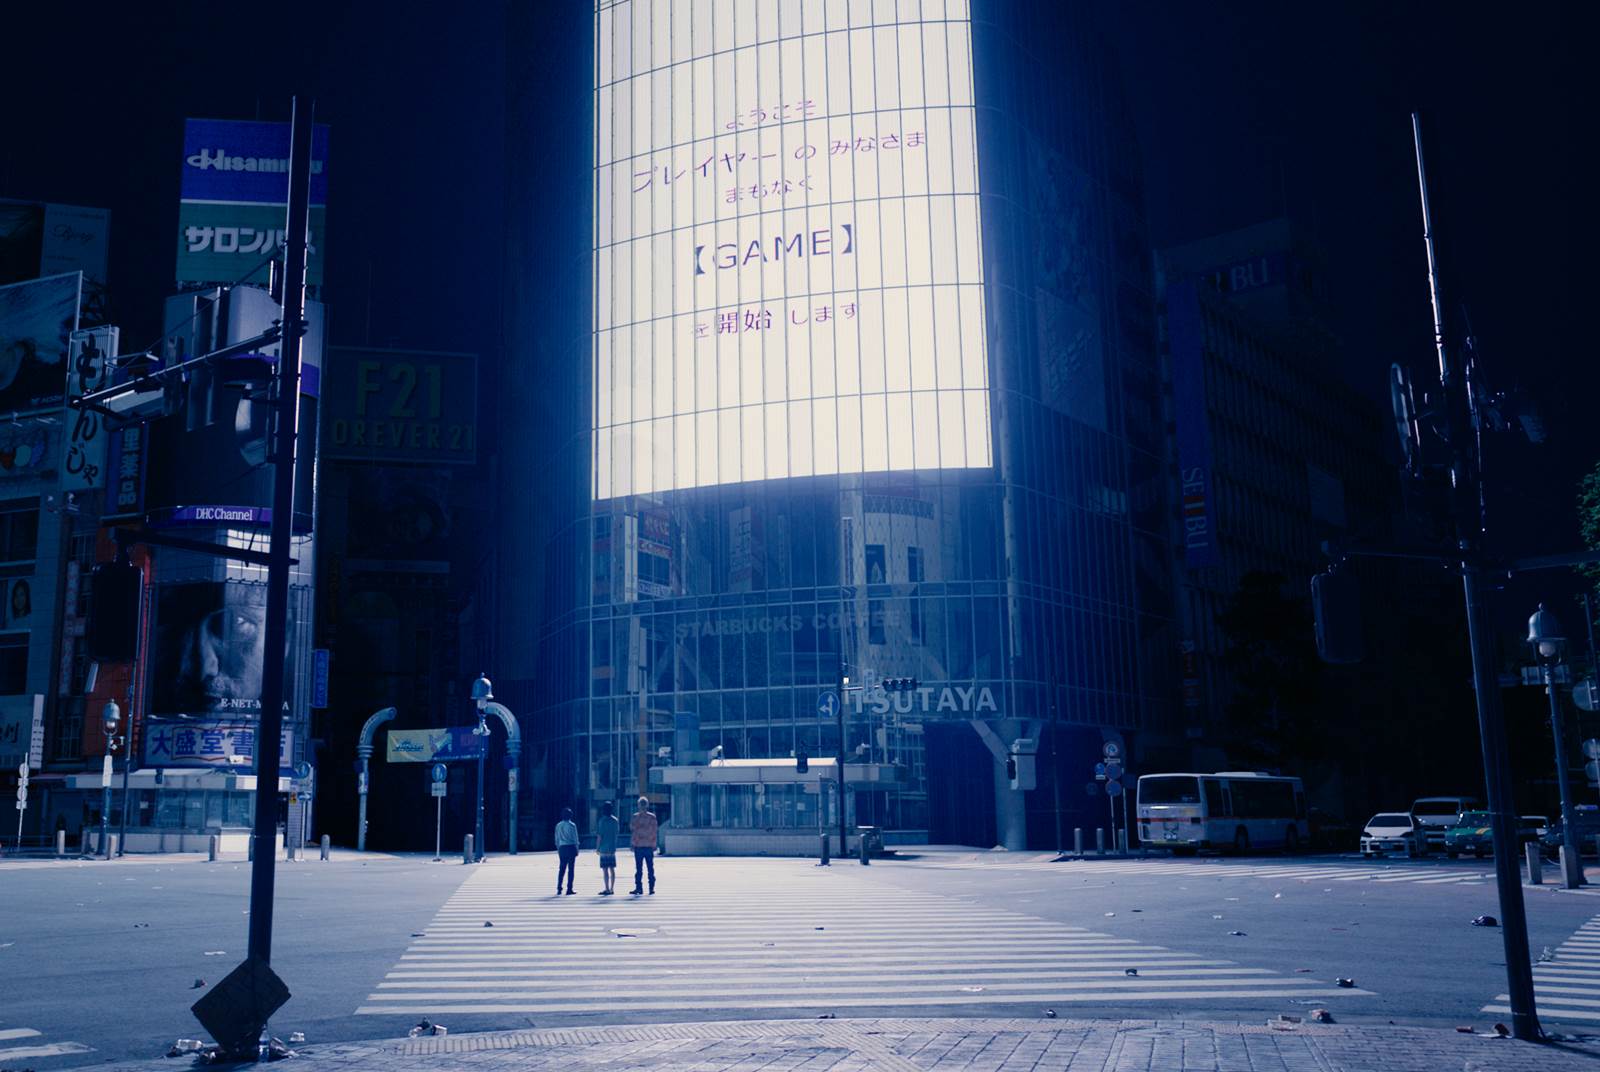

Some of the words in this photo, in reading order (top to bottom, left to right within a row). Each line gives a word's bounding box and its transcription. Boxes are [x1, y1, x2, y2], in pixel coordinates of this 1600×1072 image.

[725, 100, 816, 130] ようこそ
[725, 175, 814, 204] まもなく
[357, 360, 441, 418] F21
[449, 424, 474, 450] 21
[195, 507, 214, 520] DHC
[214, 508, 253, 521] Channel
[674, 614, 803, 639] STARBUCKS
[848, 686, 998, 714] TSUTAYA
[151, 729, 286, 757] 大盛堂書
